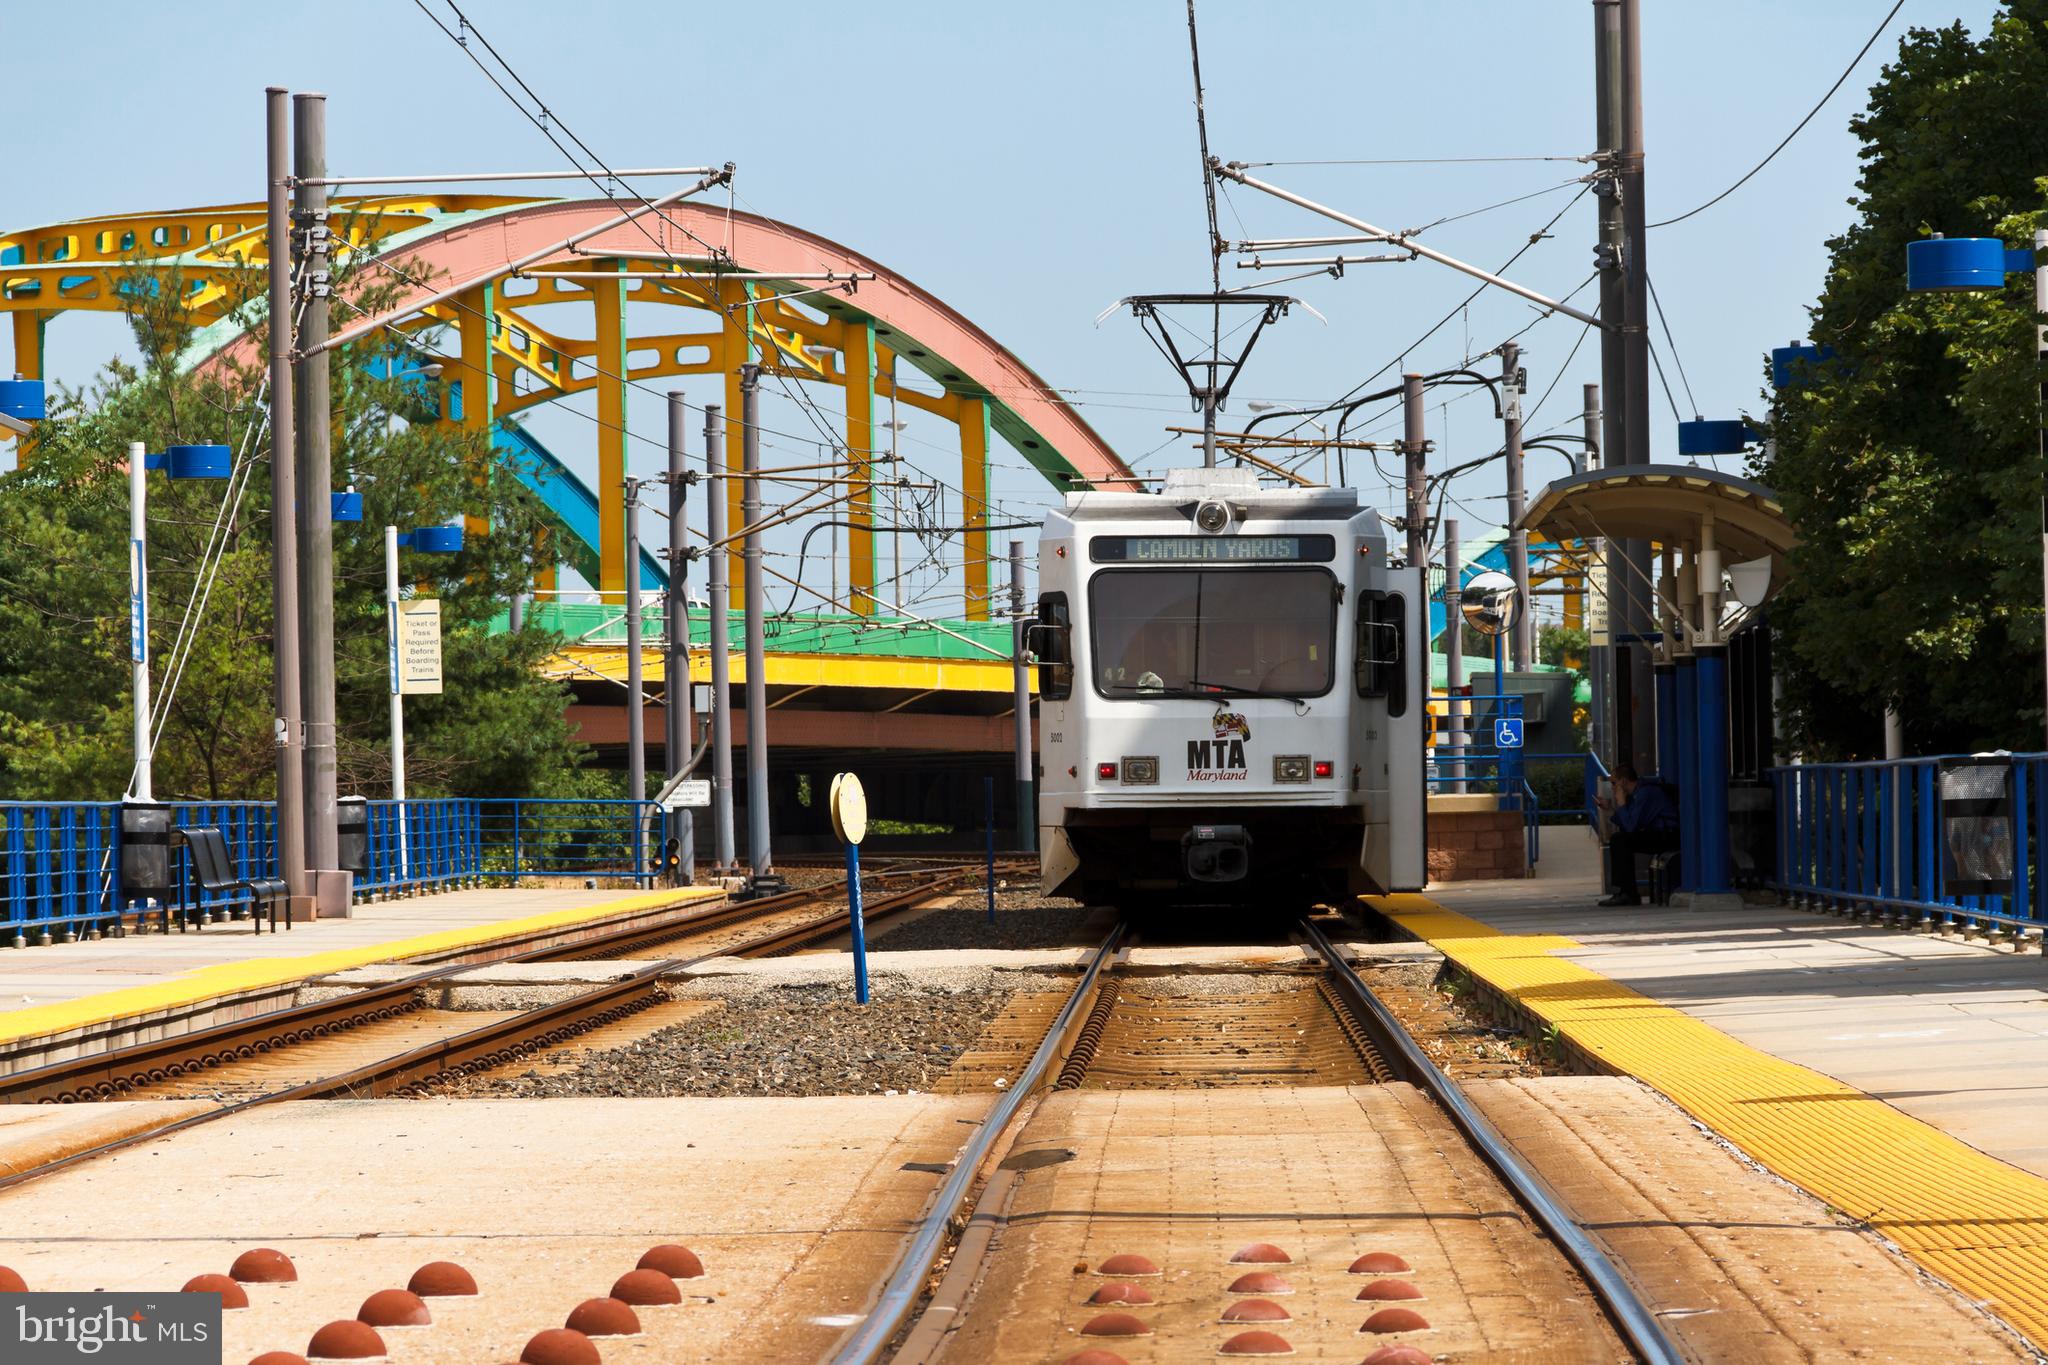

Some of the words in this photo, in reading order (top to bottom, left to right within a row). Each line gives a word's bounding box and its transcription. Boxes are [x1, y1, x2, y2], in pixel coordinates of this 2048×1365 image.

[1136, 538, 1217, 559] CAMDEN
[1225, 538, 1291, 559] YARDS
[410, 647, 435, 655] Before
[1187, 740, 1247, 769] MTA
[1186, 769, 1248, 782] Maryland
